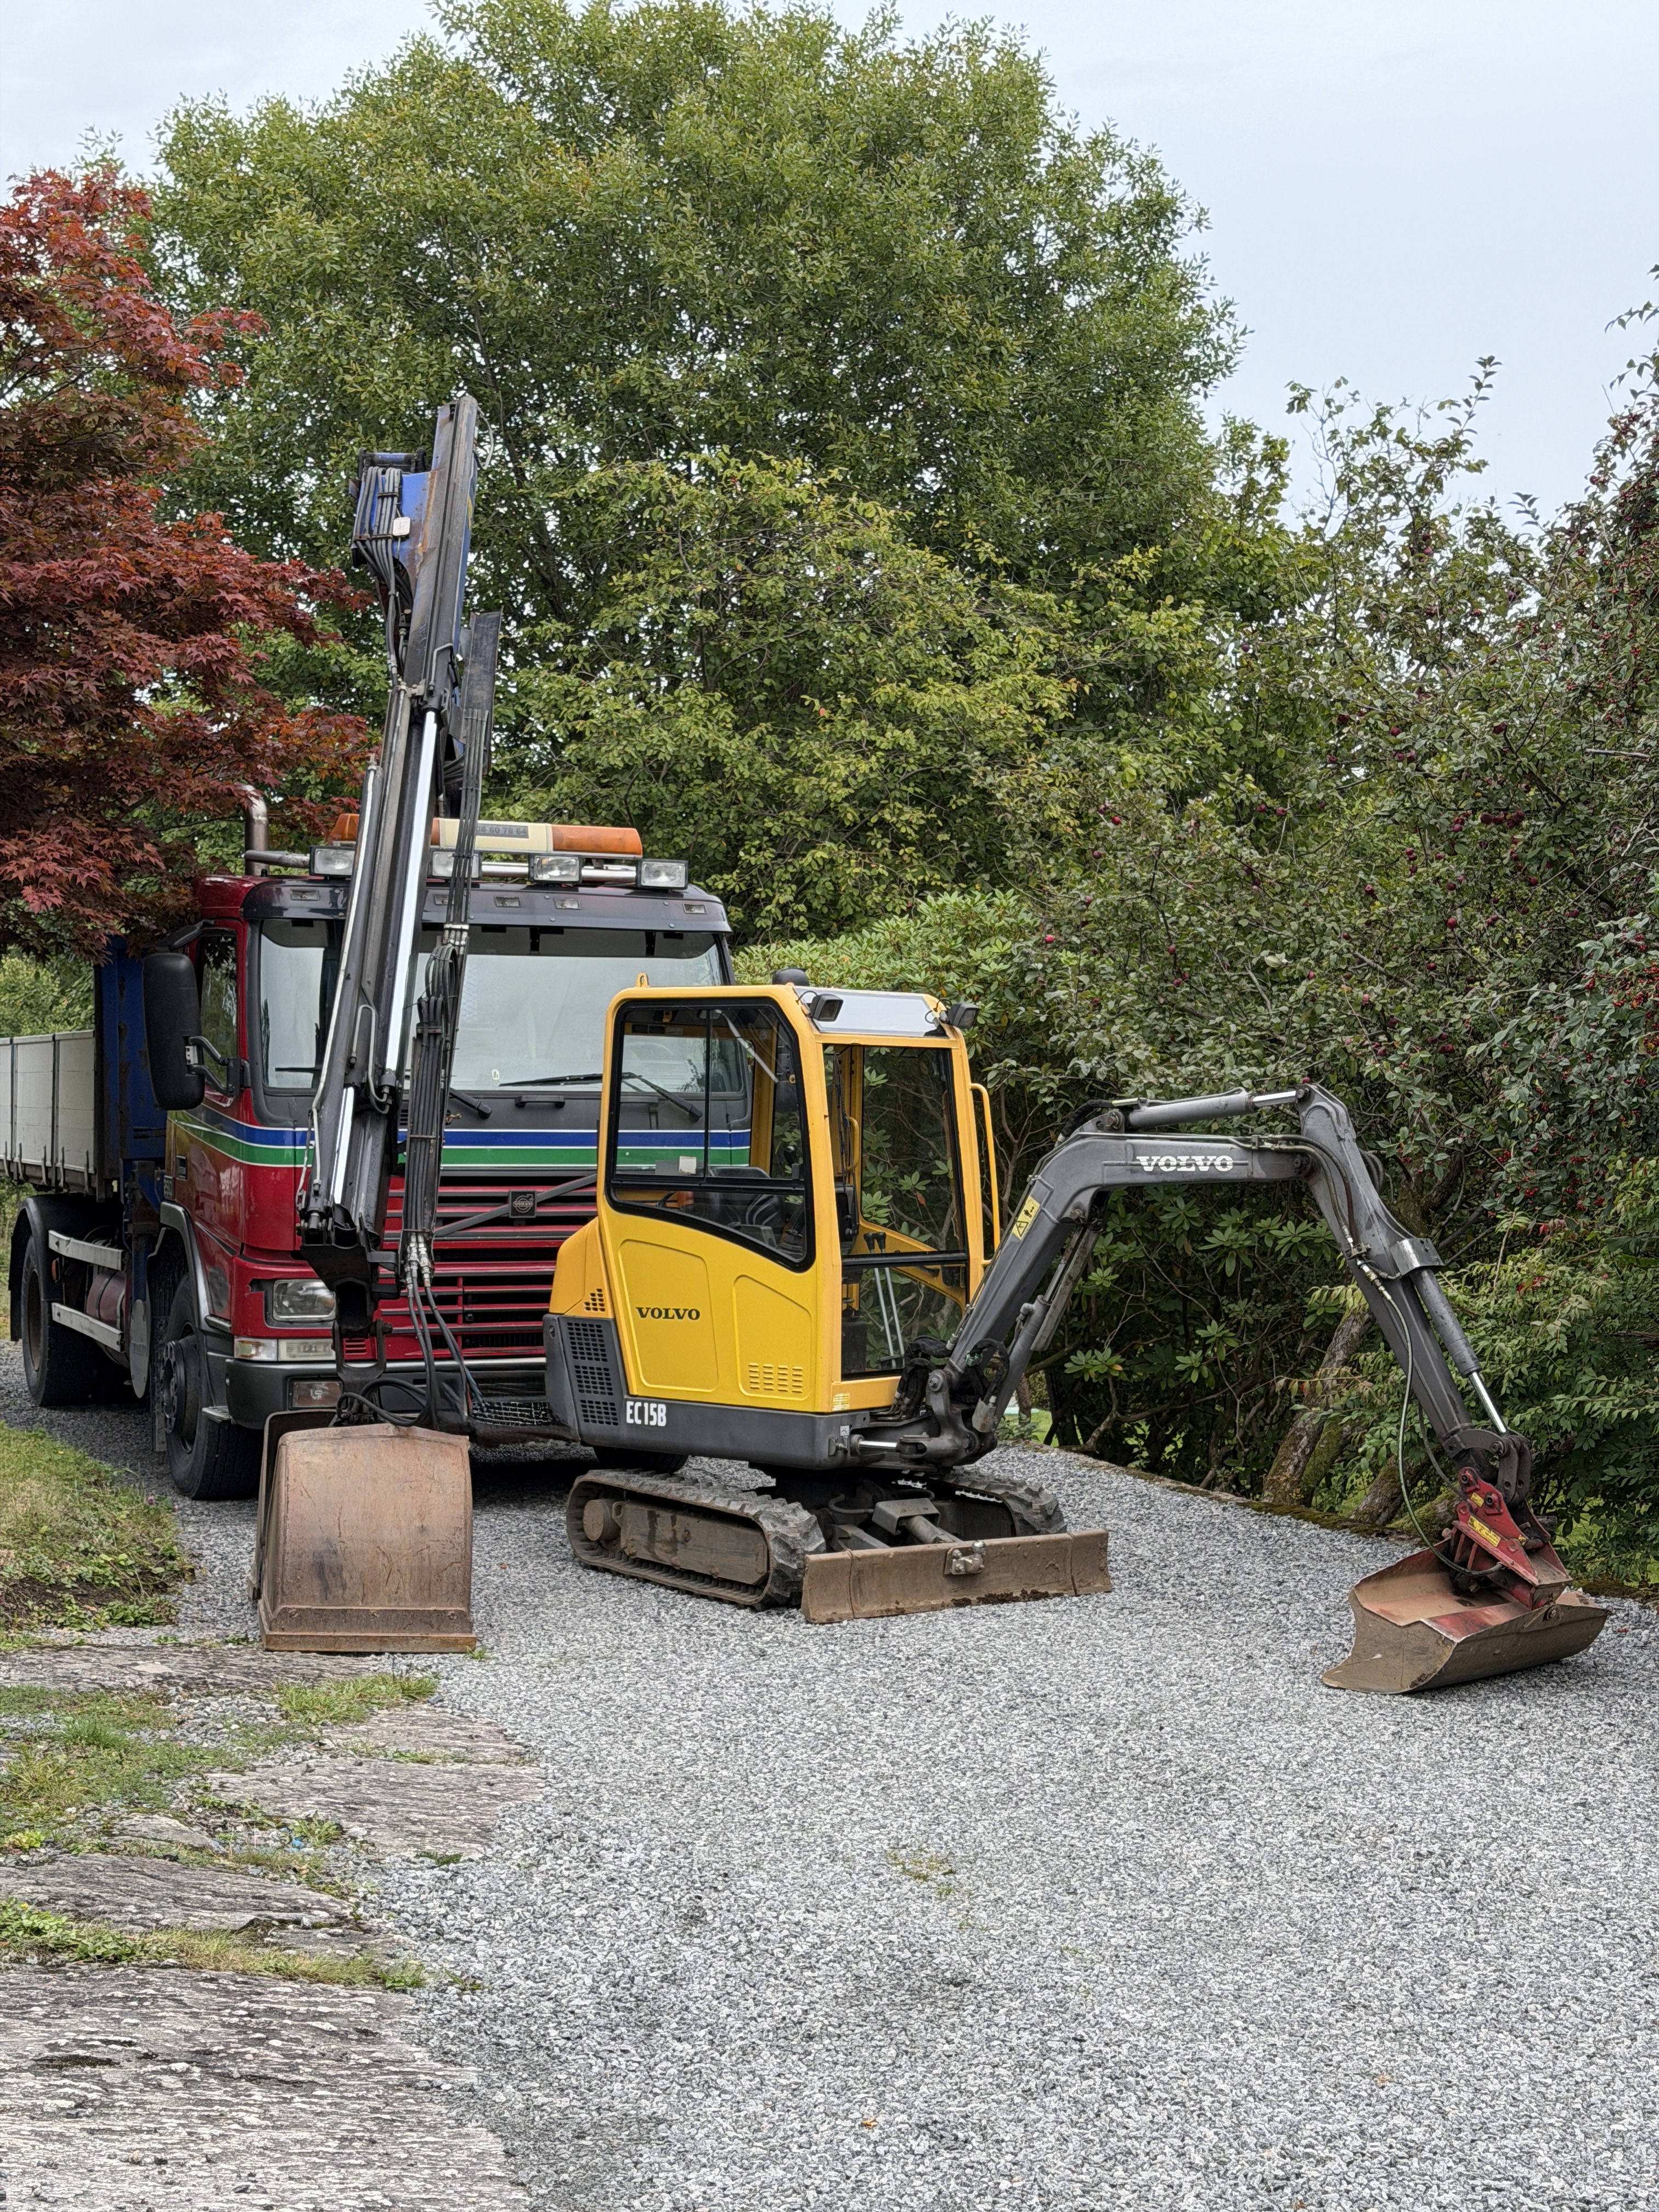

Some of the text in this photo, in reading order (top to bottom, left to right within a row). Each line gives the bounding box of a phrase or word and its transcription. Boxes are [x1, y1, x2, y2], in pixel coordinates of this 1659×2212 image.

[1136, 1155, 1233, 1172] VOLVO
[635, 1307, 700, 1321] VOLVO
[626, 1401, 667, 1427] EC15B
